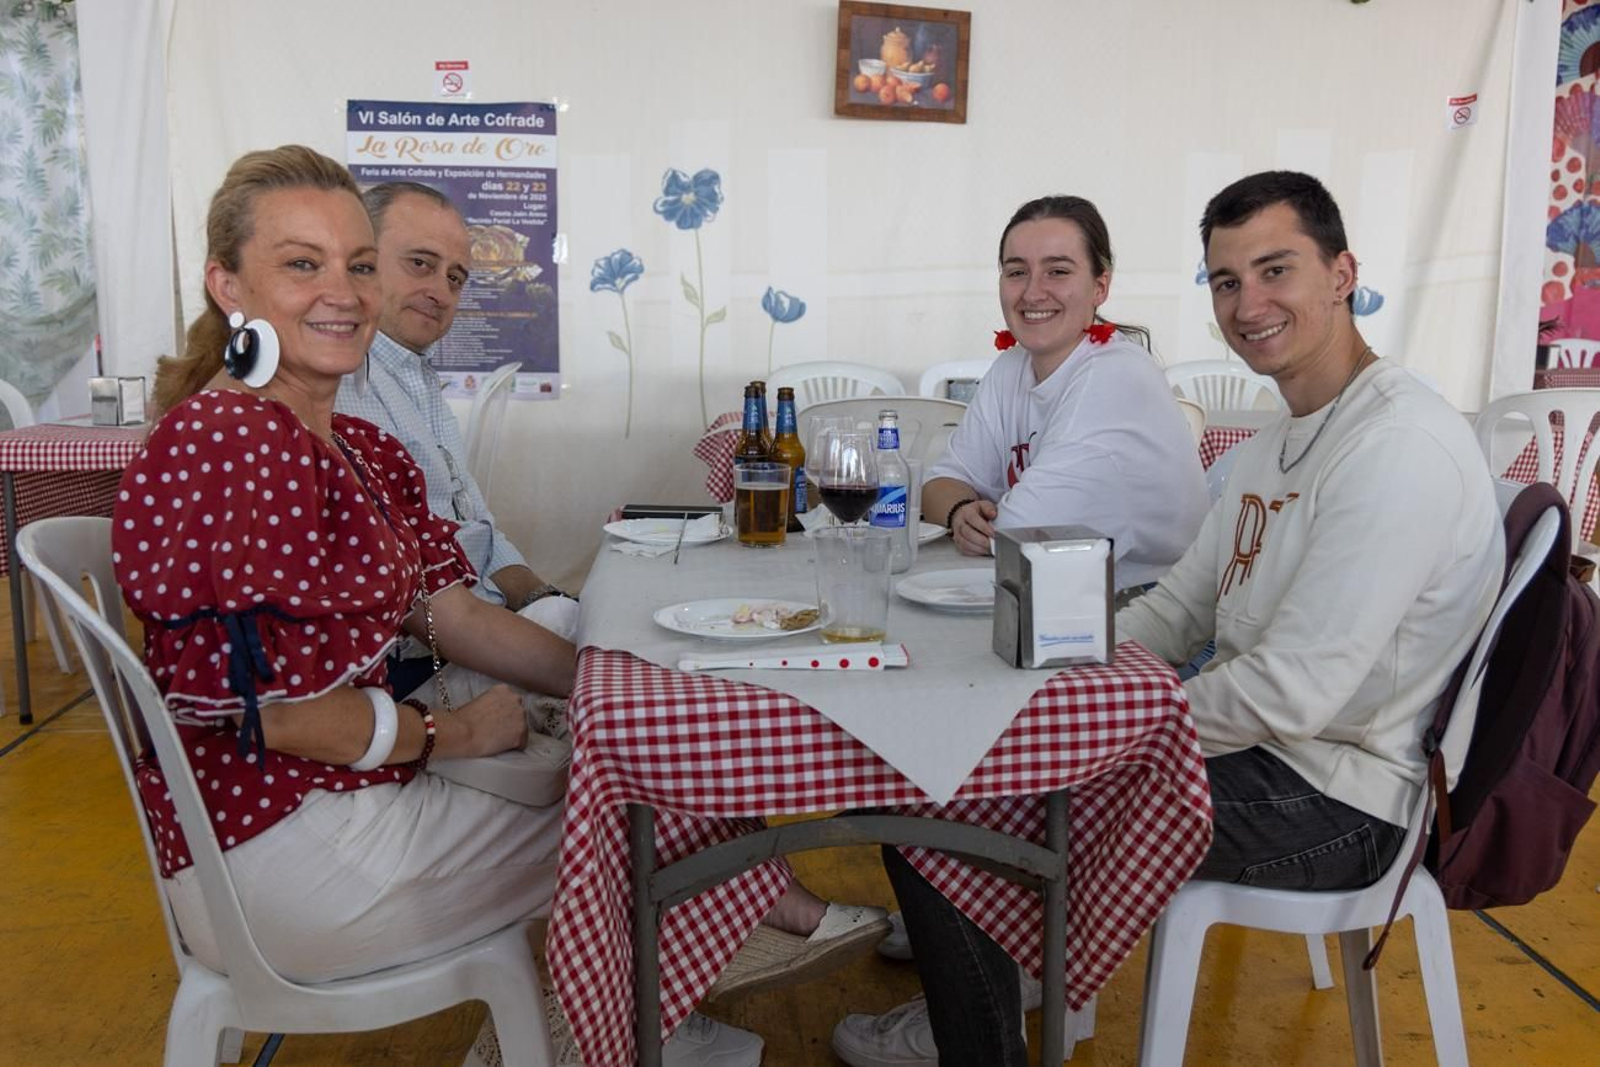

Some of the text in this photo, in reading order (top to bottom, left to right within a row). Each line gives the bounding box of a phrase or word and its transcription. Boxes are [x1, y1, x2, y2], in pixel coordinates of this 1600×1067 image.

[359, 111, 545, 128] VI Salón de Arte Cofrade
[356, 135, 546, 162] La Rosa de Oro
[361, 167, 546, 179] Feria de Arte Cofrade y Exposición de Hermandades
[506, 181, 521, 191] 22
[523, 184, 530, 193] y
[478, 192, 517, 200] Noviembre
